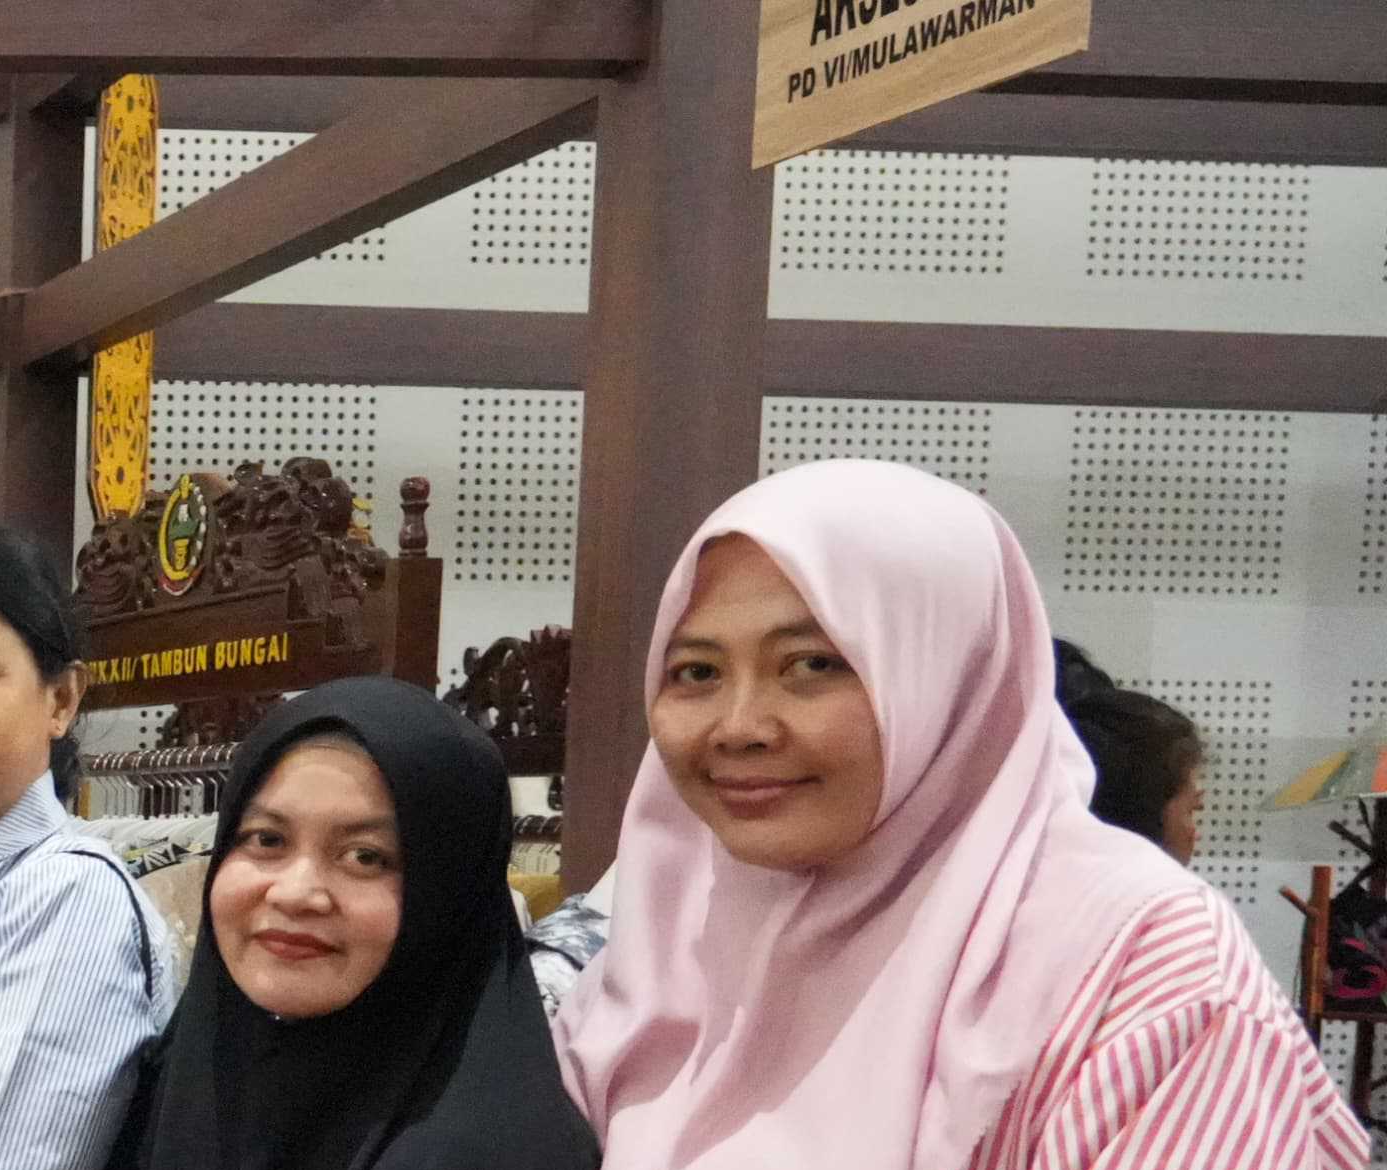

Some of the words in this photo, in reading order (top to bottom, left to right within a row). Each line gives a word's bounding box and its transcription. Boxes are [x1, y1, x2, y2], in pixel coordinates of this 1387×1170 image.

[788, 67, 816, 103] PD
[141, 644, 208, 680] TAMBUN
[214, 632, 289, 670] BUNGAI
